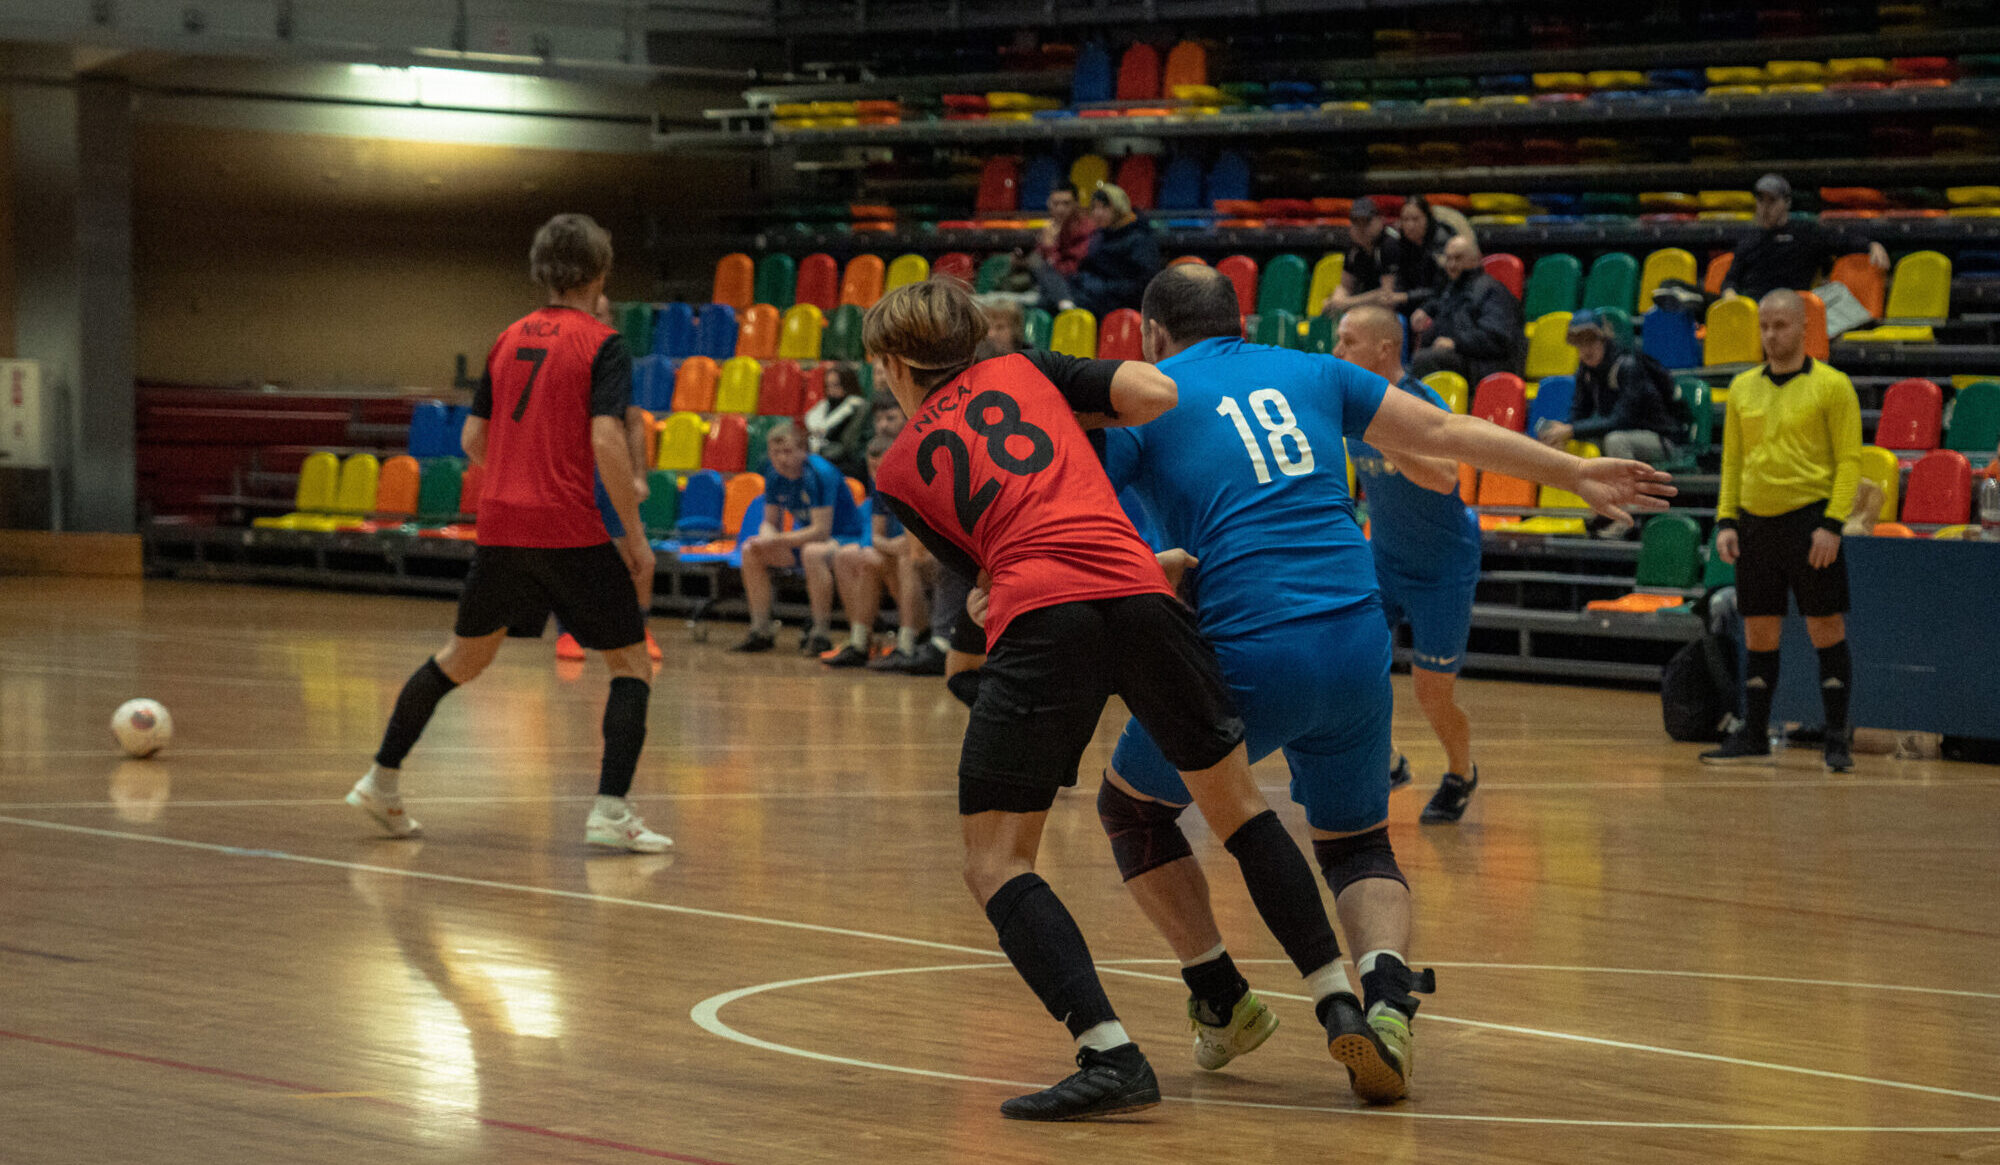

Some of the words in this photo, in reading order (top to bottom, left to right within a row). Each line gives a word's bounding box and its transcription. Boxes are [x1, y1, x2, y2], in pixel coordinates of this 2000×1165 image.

[512, 347, 548, 422] 7
[916, 390, 1054, 536] 28
[1216, 388, 1315, 484] 18
